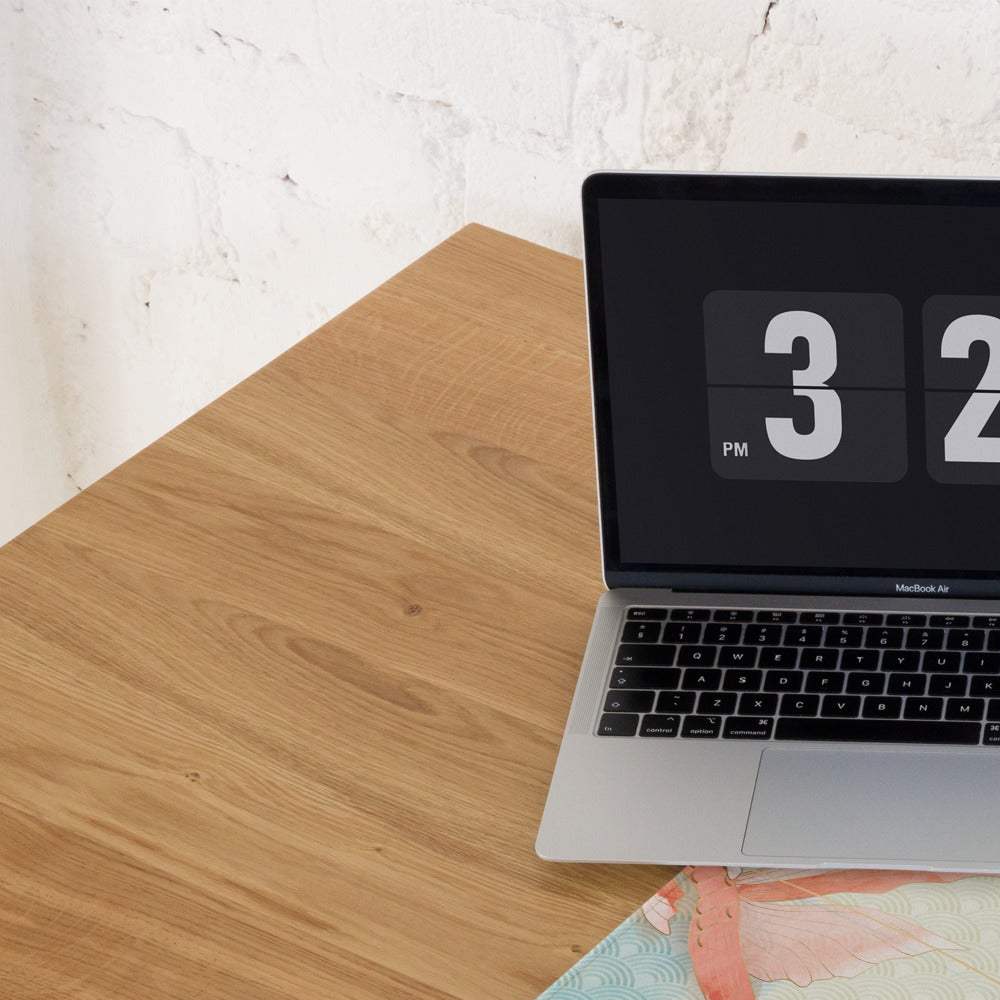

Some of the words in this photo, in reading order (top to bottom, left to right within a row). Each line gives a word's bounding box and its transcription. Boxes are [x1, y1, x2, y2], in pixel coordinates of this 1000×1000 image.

[764, 310, 842, 460] 3
[722, 442, 749, 458] PM
[895, 583, 936, 593] MacBook
[937, 584, 950, 593] Air
[689, 728, 714, 736] option
